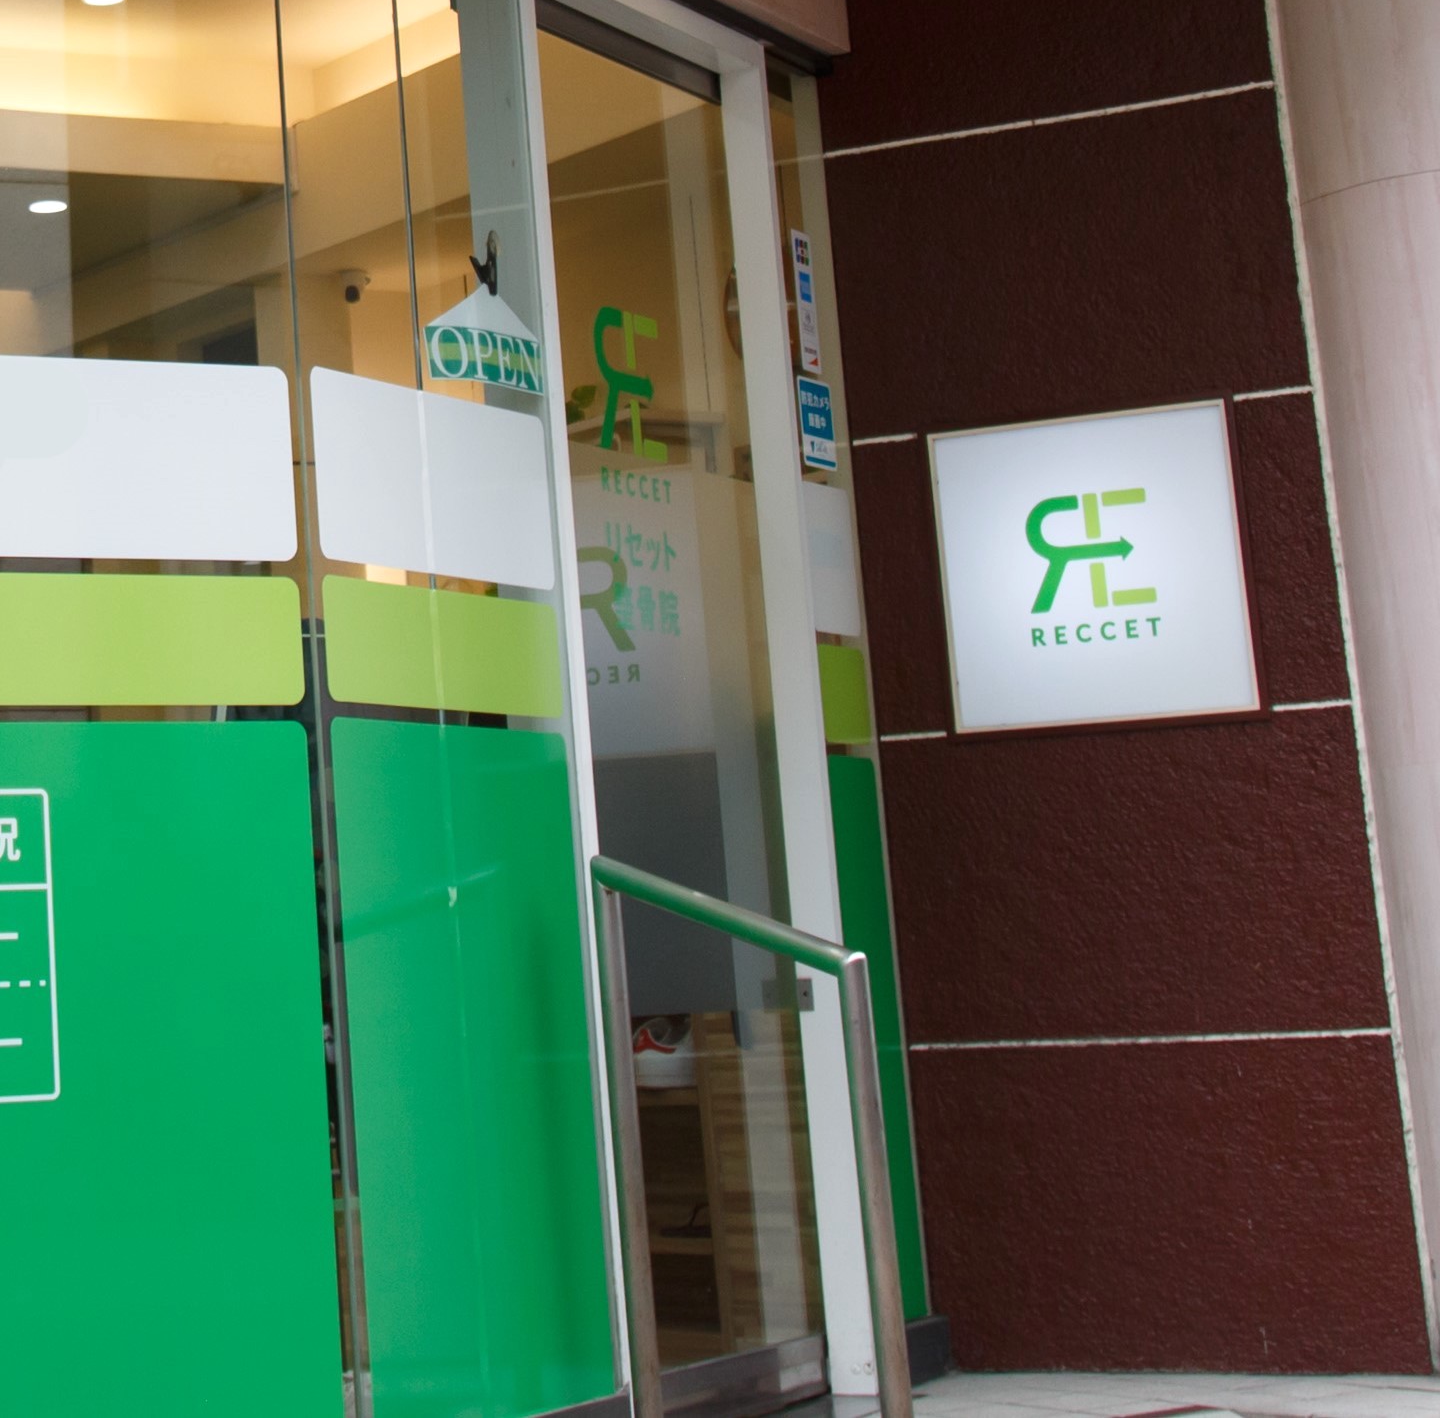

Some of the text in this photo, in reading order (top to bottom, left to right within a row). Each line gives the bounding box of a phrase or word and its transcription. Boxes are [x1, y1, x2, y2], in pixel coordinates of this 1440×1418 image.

[430, 326, 540, 392] OPEN
[600, 465, 673, 505] RECCET
[605, 521, 677, 573] リセット
[1031, 617, 1162, 648] RECCET
